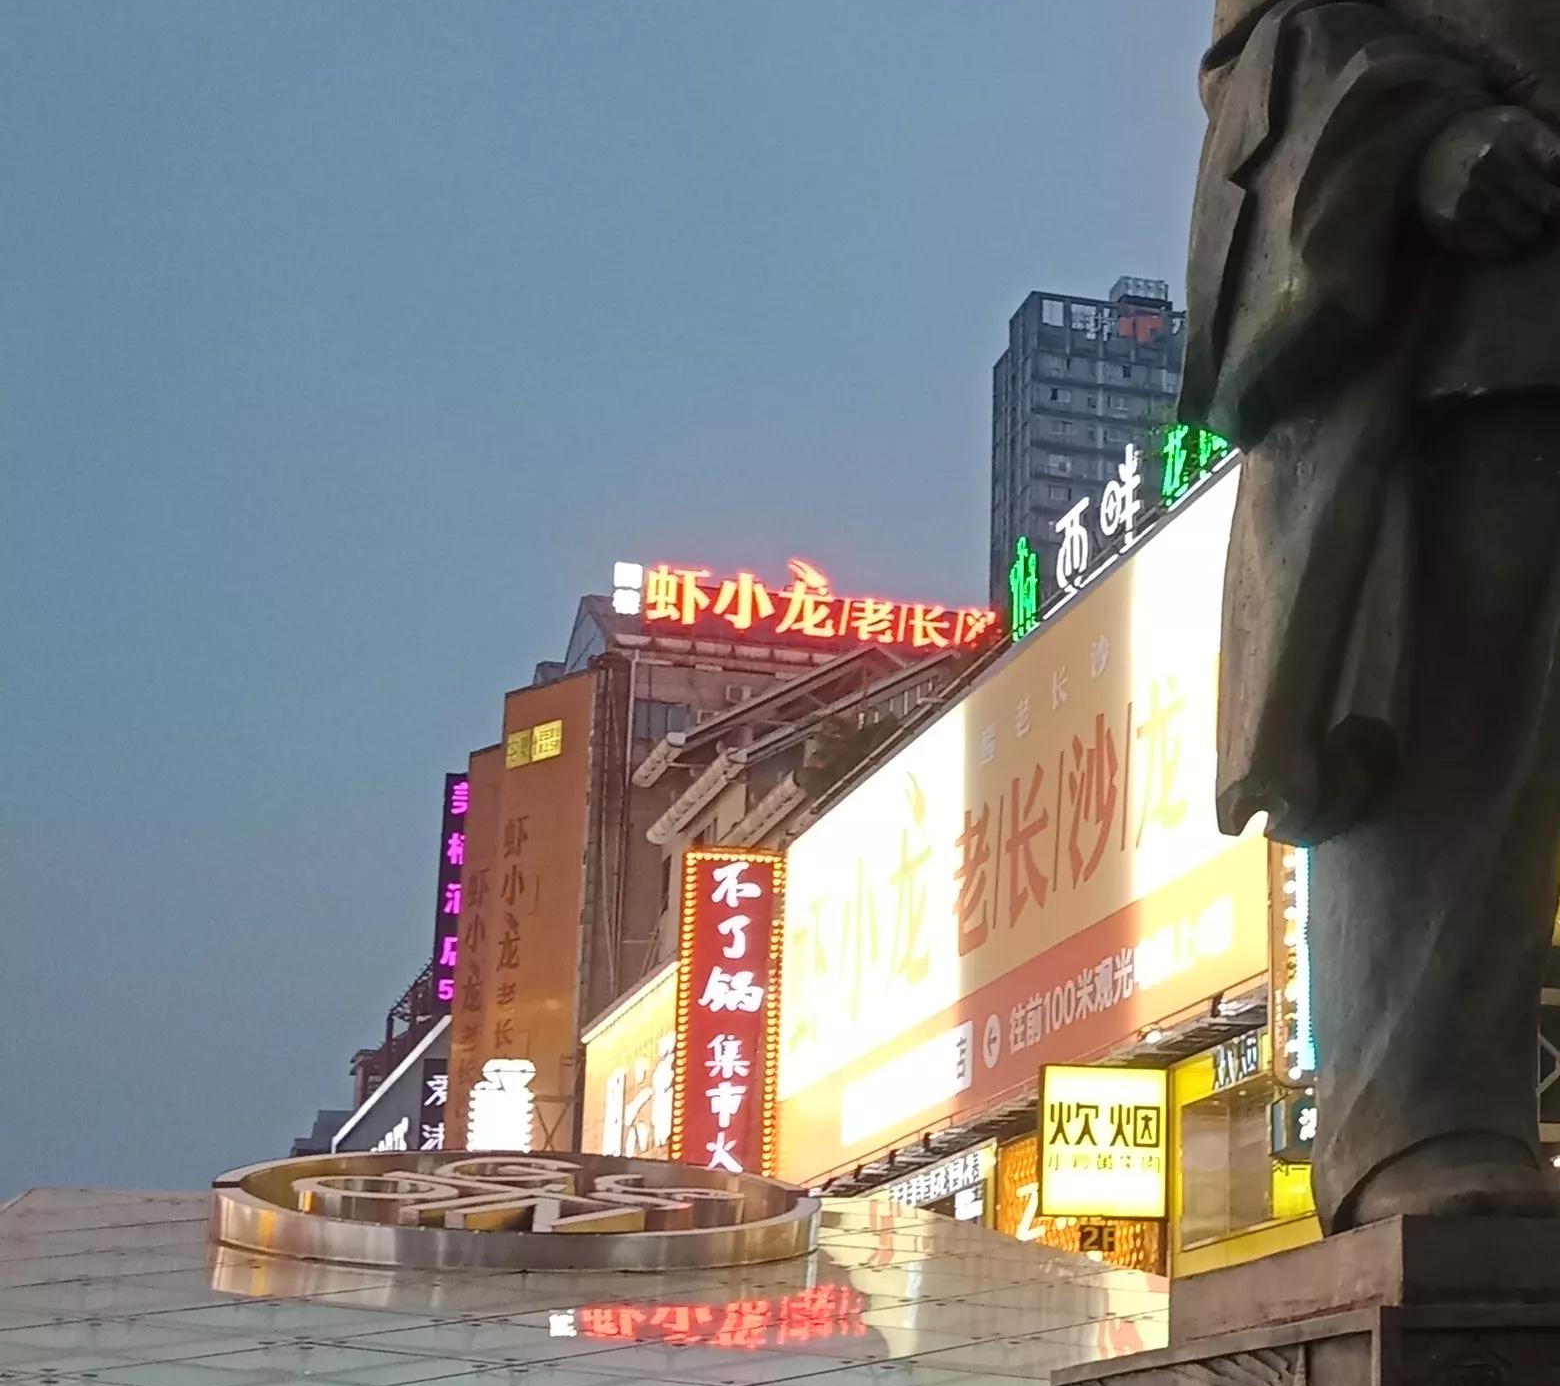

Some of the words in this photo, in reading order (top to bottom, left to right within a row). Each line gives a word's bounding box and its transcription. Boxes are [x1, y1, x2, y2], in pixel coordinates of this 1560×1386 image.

[698, 860, 764, 1013] 不了锅
[1048, 1101, 1161, 1149] 炊烟
